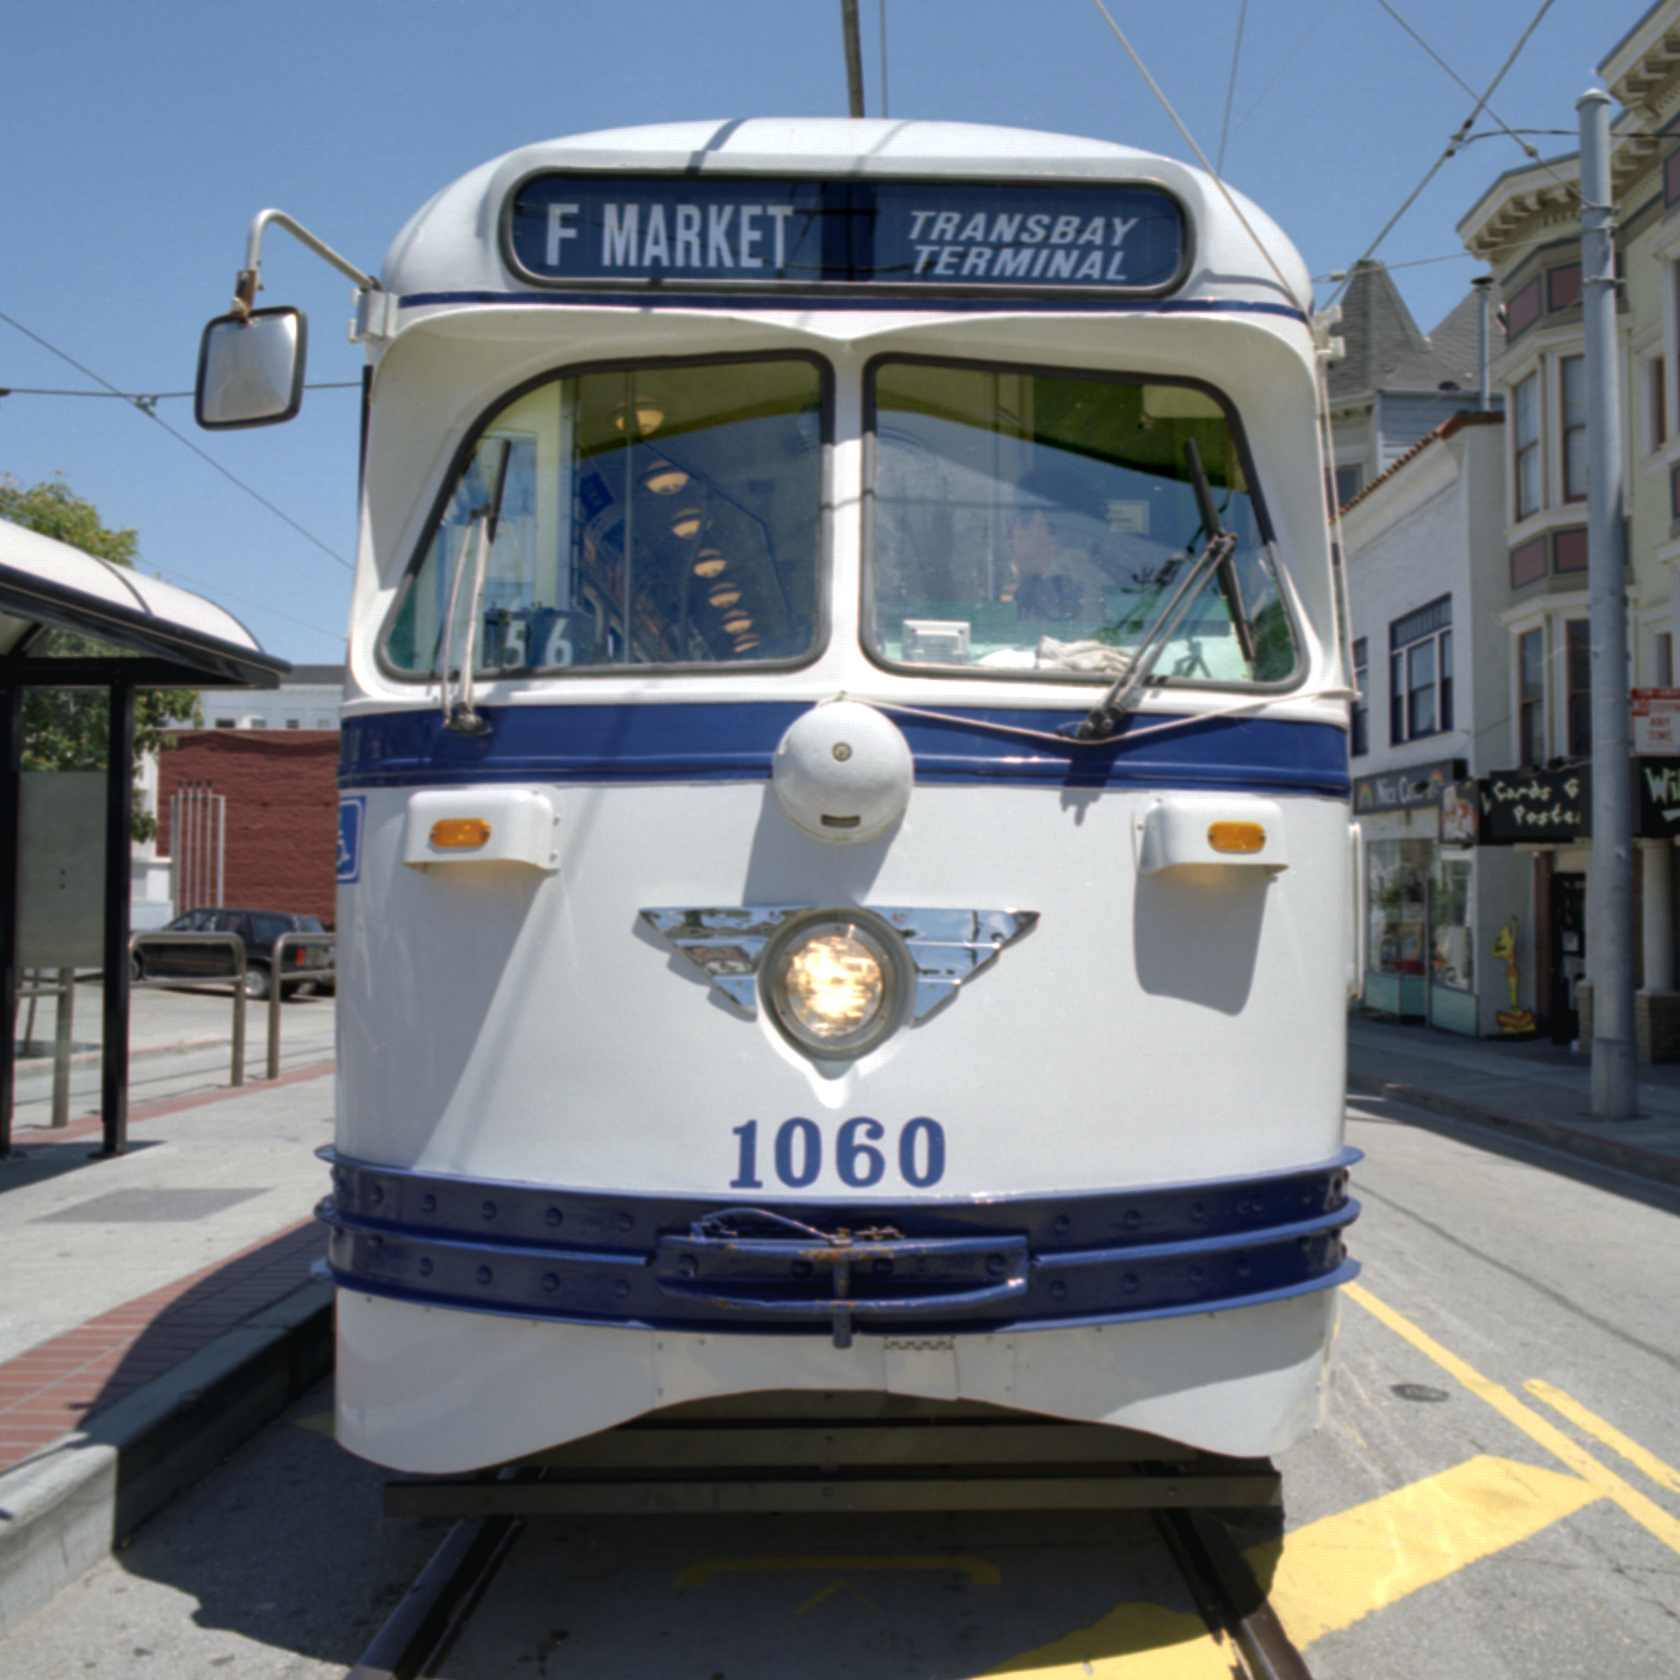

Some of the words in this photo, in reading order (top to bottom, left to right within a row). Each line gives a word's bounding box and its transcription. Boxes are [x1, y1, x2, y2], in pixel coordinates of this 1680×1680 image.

[546, 203, 579, 266] F
[602, 203, 794, 268] MARKET
[909, 211, 1139, 246] TRANSBAY
[913, 245, 1127, 281] TERMINAL
[1493, 780, 1552, 802] Cards
[1644, 766, 1680, 804] Wi
[1513, 804, 1580, 826] Poste
[729, 1116, 946, 1190] 1060
